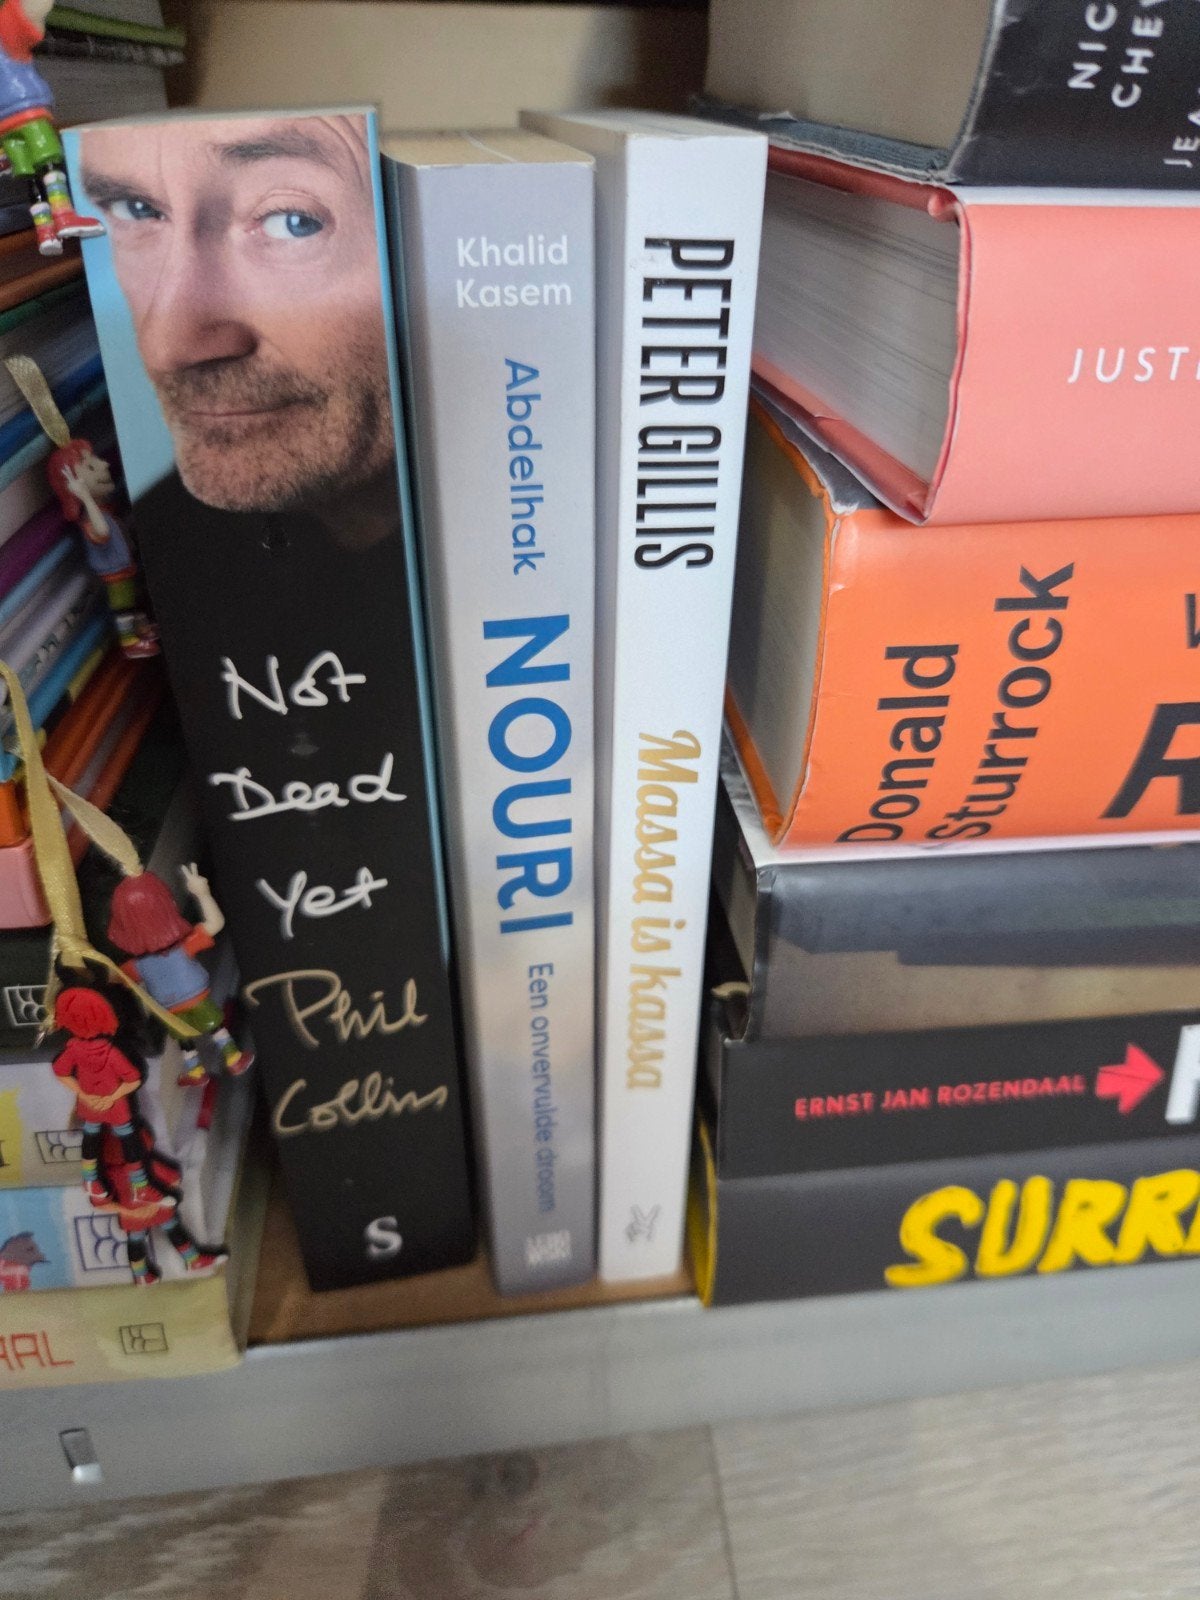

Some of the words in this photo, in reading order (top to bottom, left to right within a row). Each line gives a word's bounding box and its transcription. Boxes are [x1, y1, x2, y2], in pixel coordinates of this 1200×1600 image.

[1111, 0, 1167, 108] CHE
[456, 234, 569, 267] Khalid
[456, 278, 573, 309] Kasem
[639, 237, 735, 407] PETER
[504, 357, 546, 576] Abdelhak
[633, 424, 723, 571] GILLIS
[221, 650, 367, 720] Not
[924, 561, 1076, 840] Sturrock
[208, 751, 408, 822] Dead
[482, 613, 574, 935] NOURI
[834, 643, 960, 844] Donald
[631, 729, 703, 905] Massa
[255, 866, 389, 939] Yet
[630, 916, 688, 954] is
[244, 968, 429, 1049] Phil
[528, 961, 555, 1010] Een
[626, 963, 683, 1090] kassa
[273, 1069, 450, 1136] Collins
[530, 1015, 558, 1143] onvervulde
[794, 1090, 874, 1121] ERNST
[881, 1084, 931, 1111] JAN
[936, 1073, 1087, 1106] ROZENDAAL
[884, 1168, 1200, 1288] SURR
